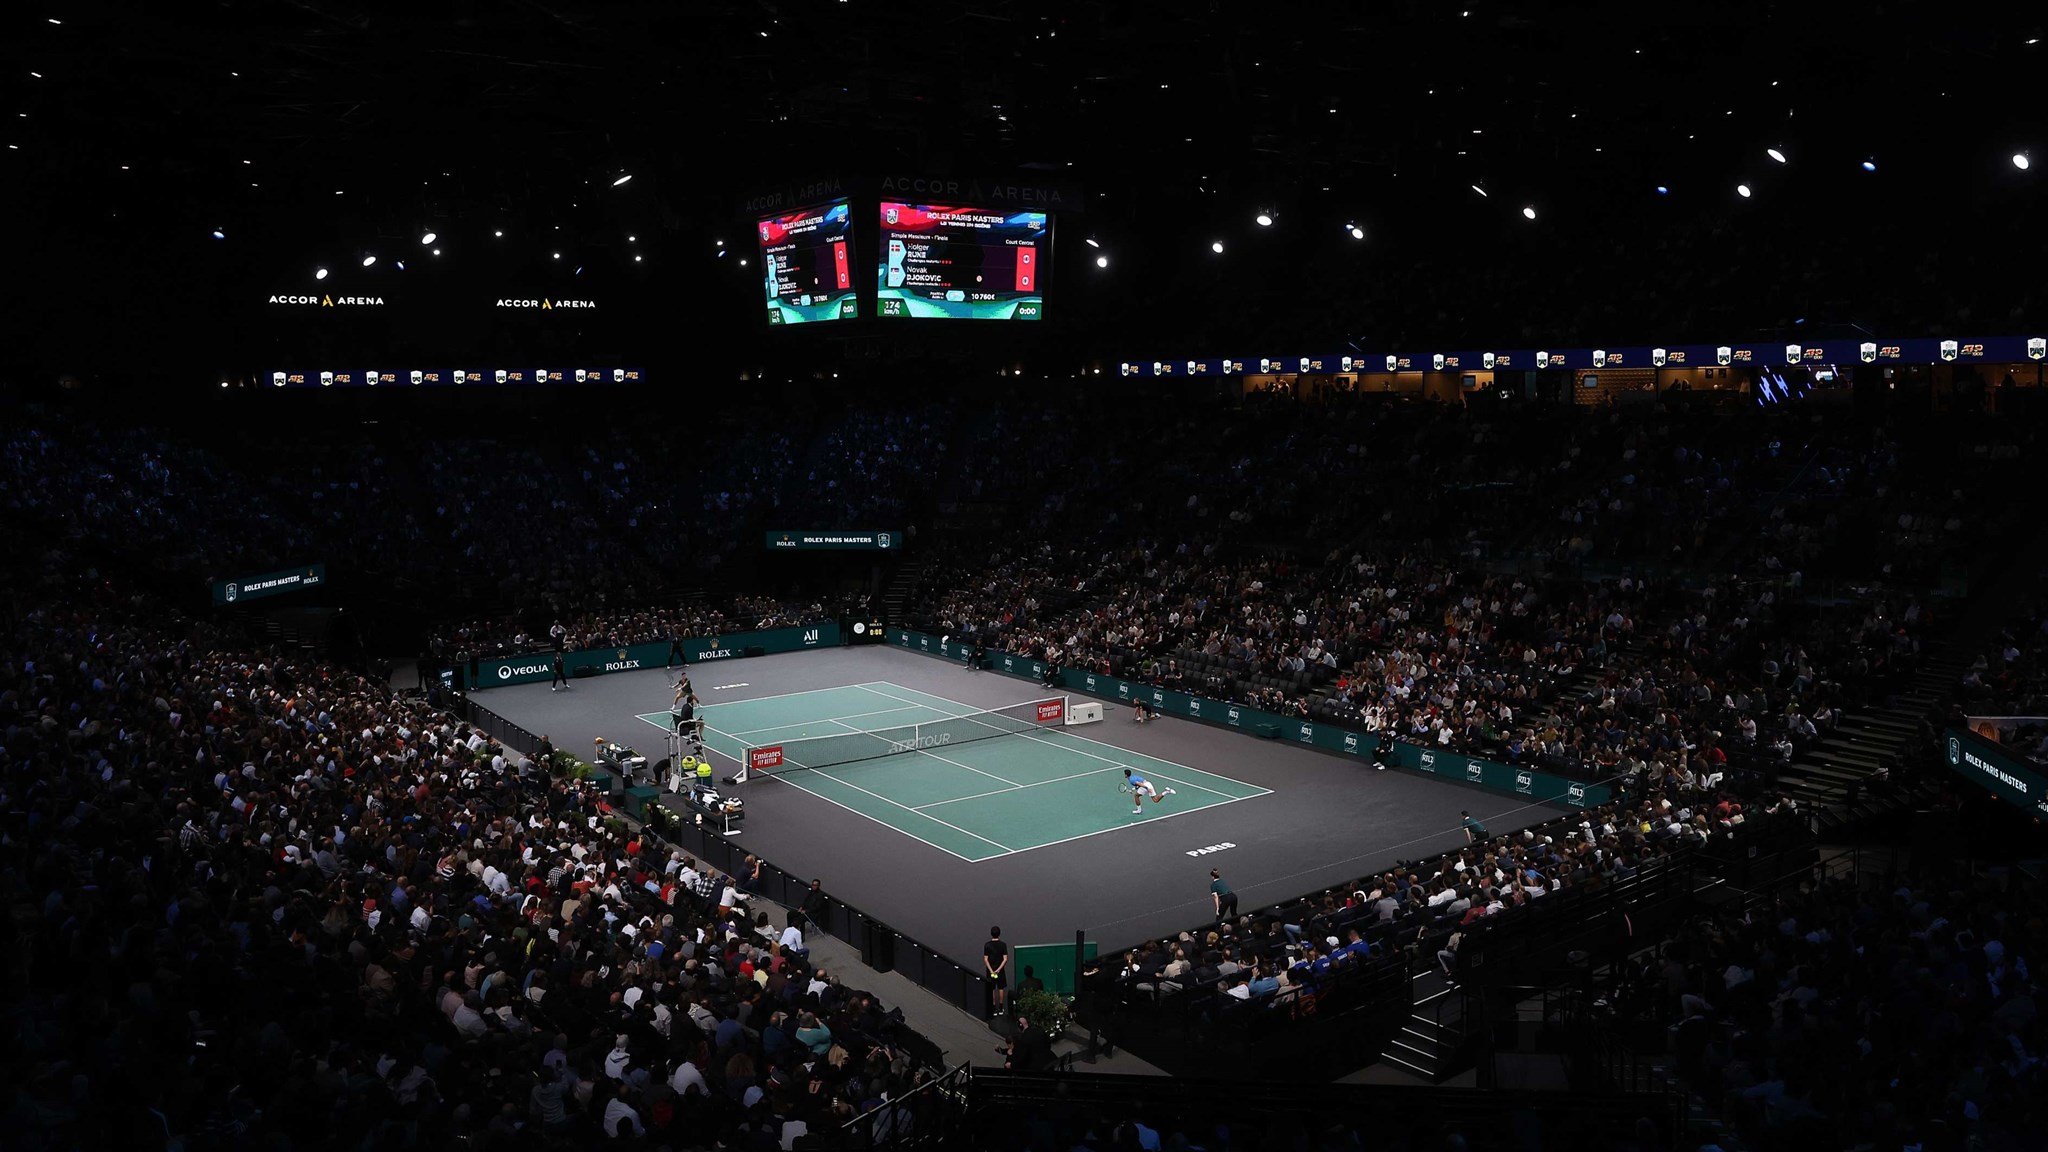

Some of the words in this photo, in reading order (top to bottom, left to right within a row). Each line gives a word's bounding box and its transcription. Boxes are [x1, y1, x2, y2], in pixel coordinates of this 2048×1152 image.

[881, 176, 960, 195] ACCOR
[992, 185, 1062, 203] ARENA
[927, 212, 950, 220] ROLEX
[972, 215, 1004, 224] MASTERS
[908, 243, 930, 252] Holger
[906, 274, 942, 282] DJOKOVIC
[269, 295, 318, 304] ACCOR
[338, 296, 384, 305] ARENA
[496, 299, 538, 308] ACCOR
[244, 582, 261, 592] ROLEX
[262, 579, 276, 589] PARIS
[278, 575, 300, 586] MASTERS
[303, 576, 318, 584] ROLEX
[699, 648, 731, 660] ROLEX
[512, 664, 549, 675] VEOLIA
[605, 660, 640, 671] ROLEX
[919, 732, 950, 748] TOUR
[754, 750, 782, 760] Emirates
[1965, 752, 1982, 769] ROLEX
[1982, 761, 1999, 778] PARIS
[2000, 770, 2028, 793] MASTERS
[1186, 842, 1236, 857] PARIS
